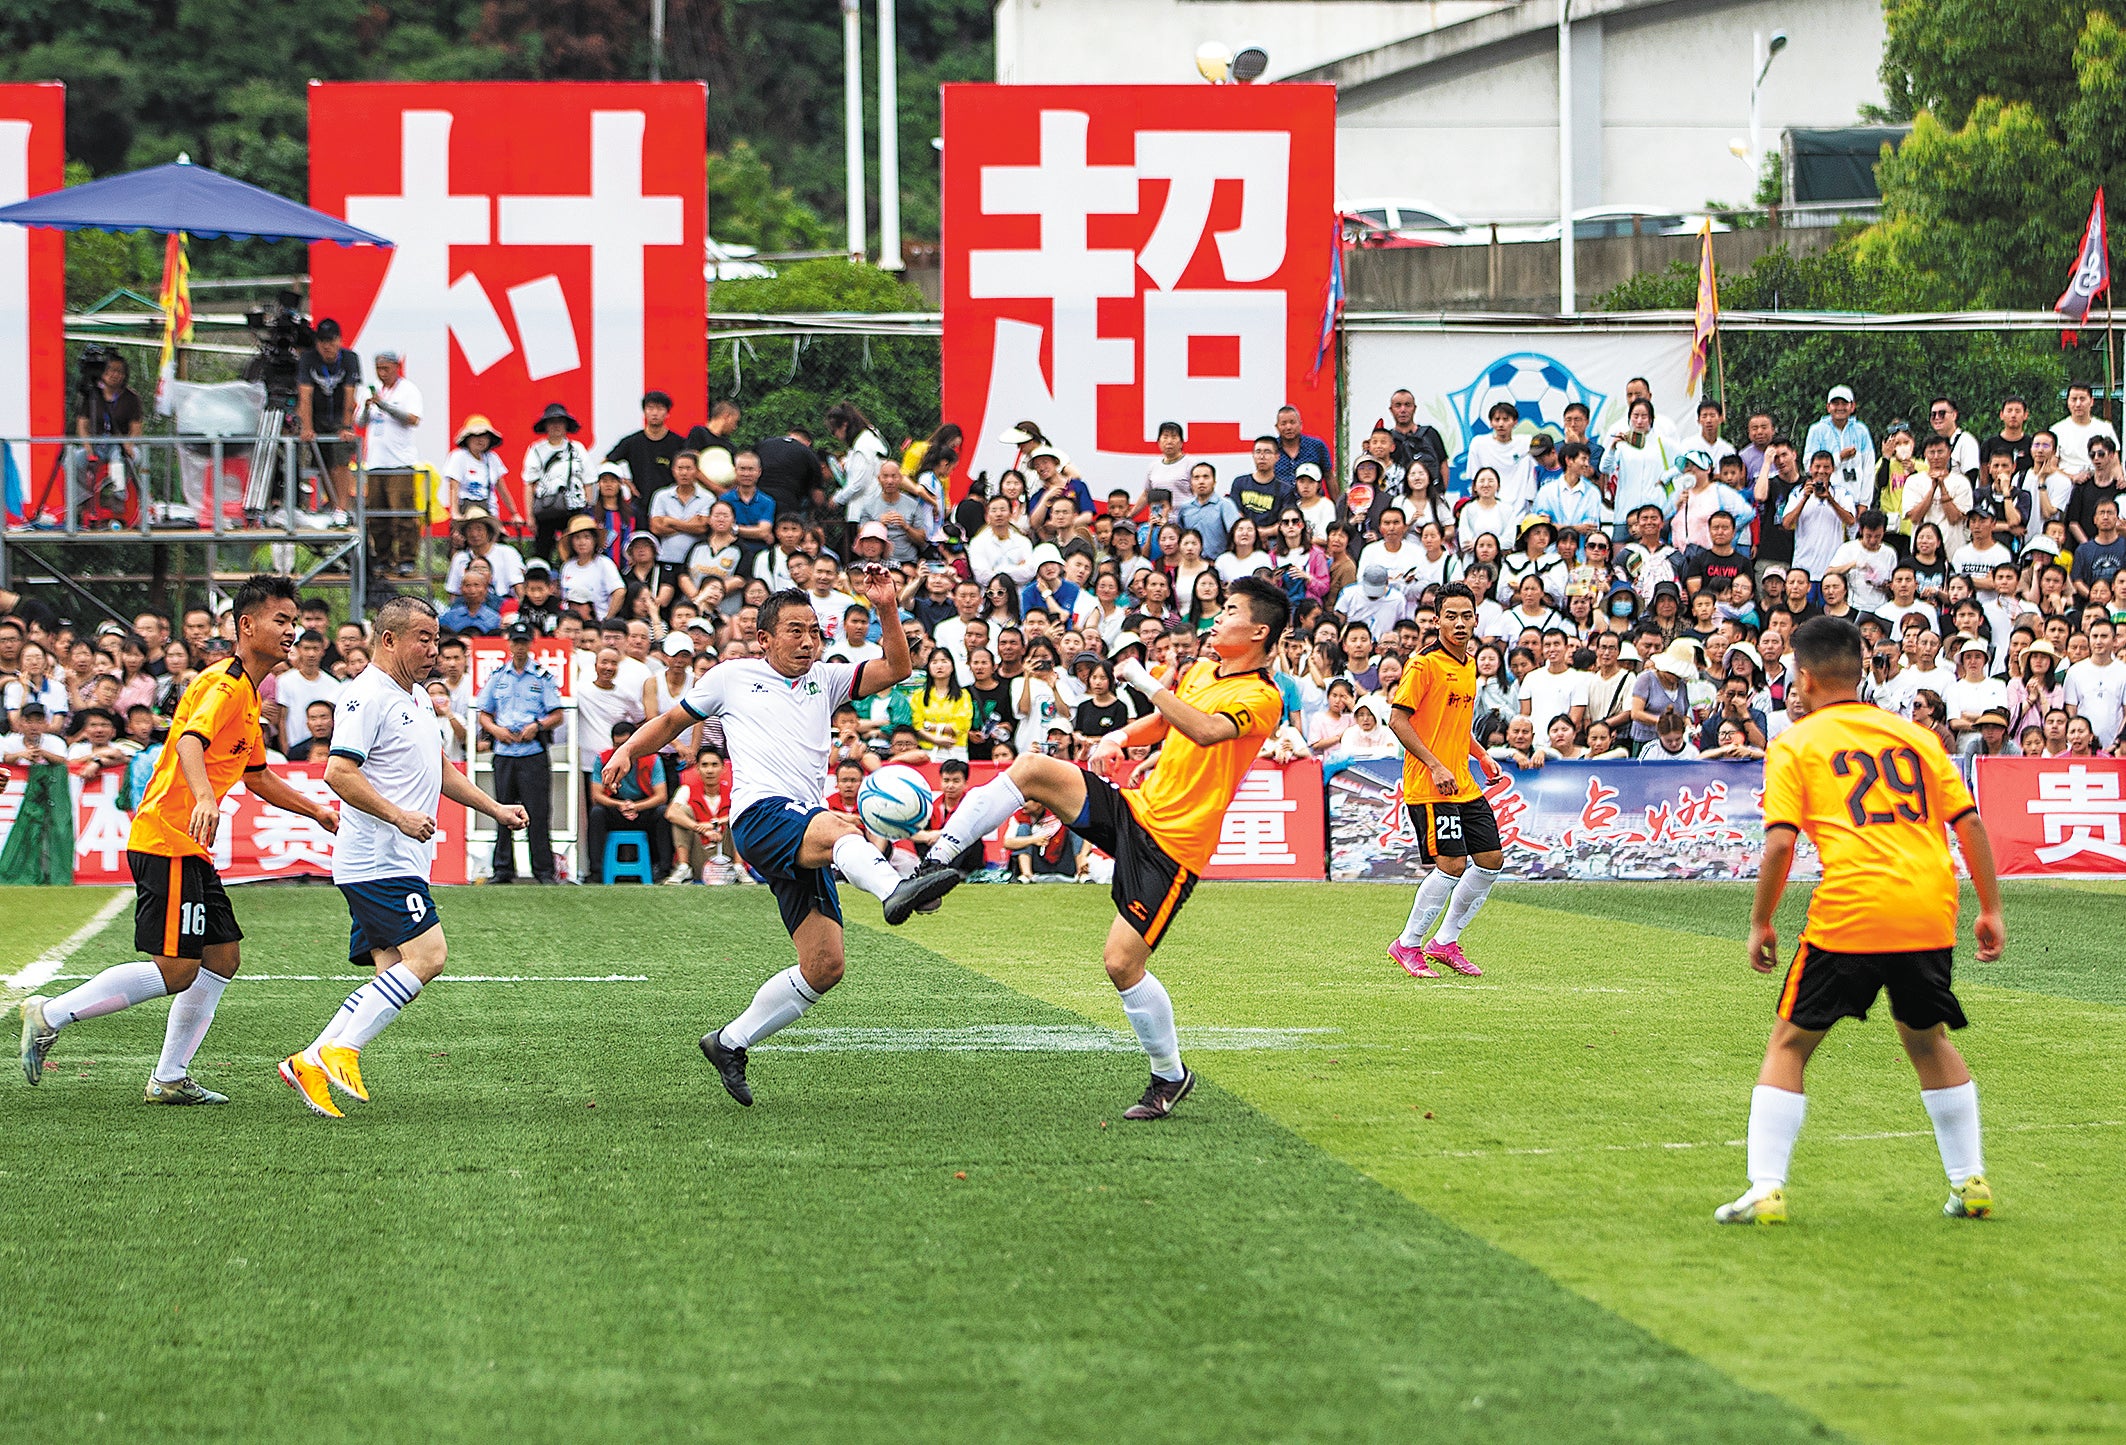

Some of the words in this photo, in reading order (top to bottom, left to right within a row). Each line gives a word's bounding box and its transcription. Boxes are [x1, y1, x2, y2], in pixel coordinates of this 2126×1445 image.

[1829, 746, 1929, 828] 29
[1436, 814, 1462, 840] 25
[2026, 763, 2126, 865] 贵
[181, 901, 206, 936] 16
[405, 892, 427, 923] 9
